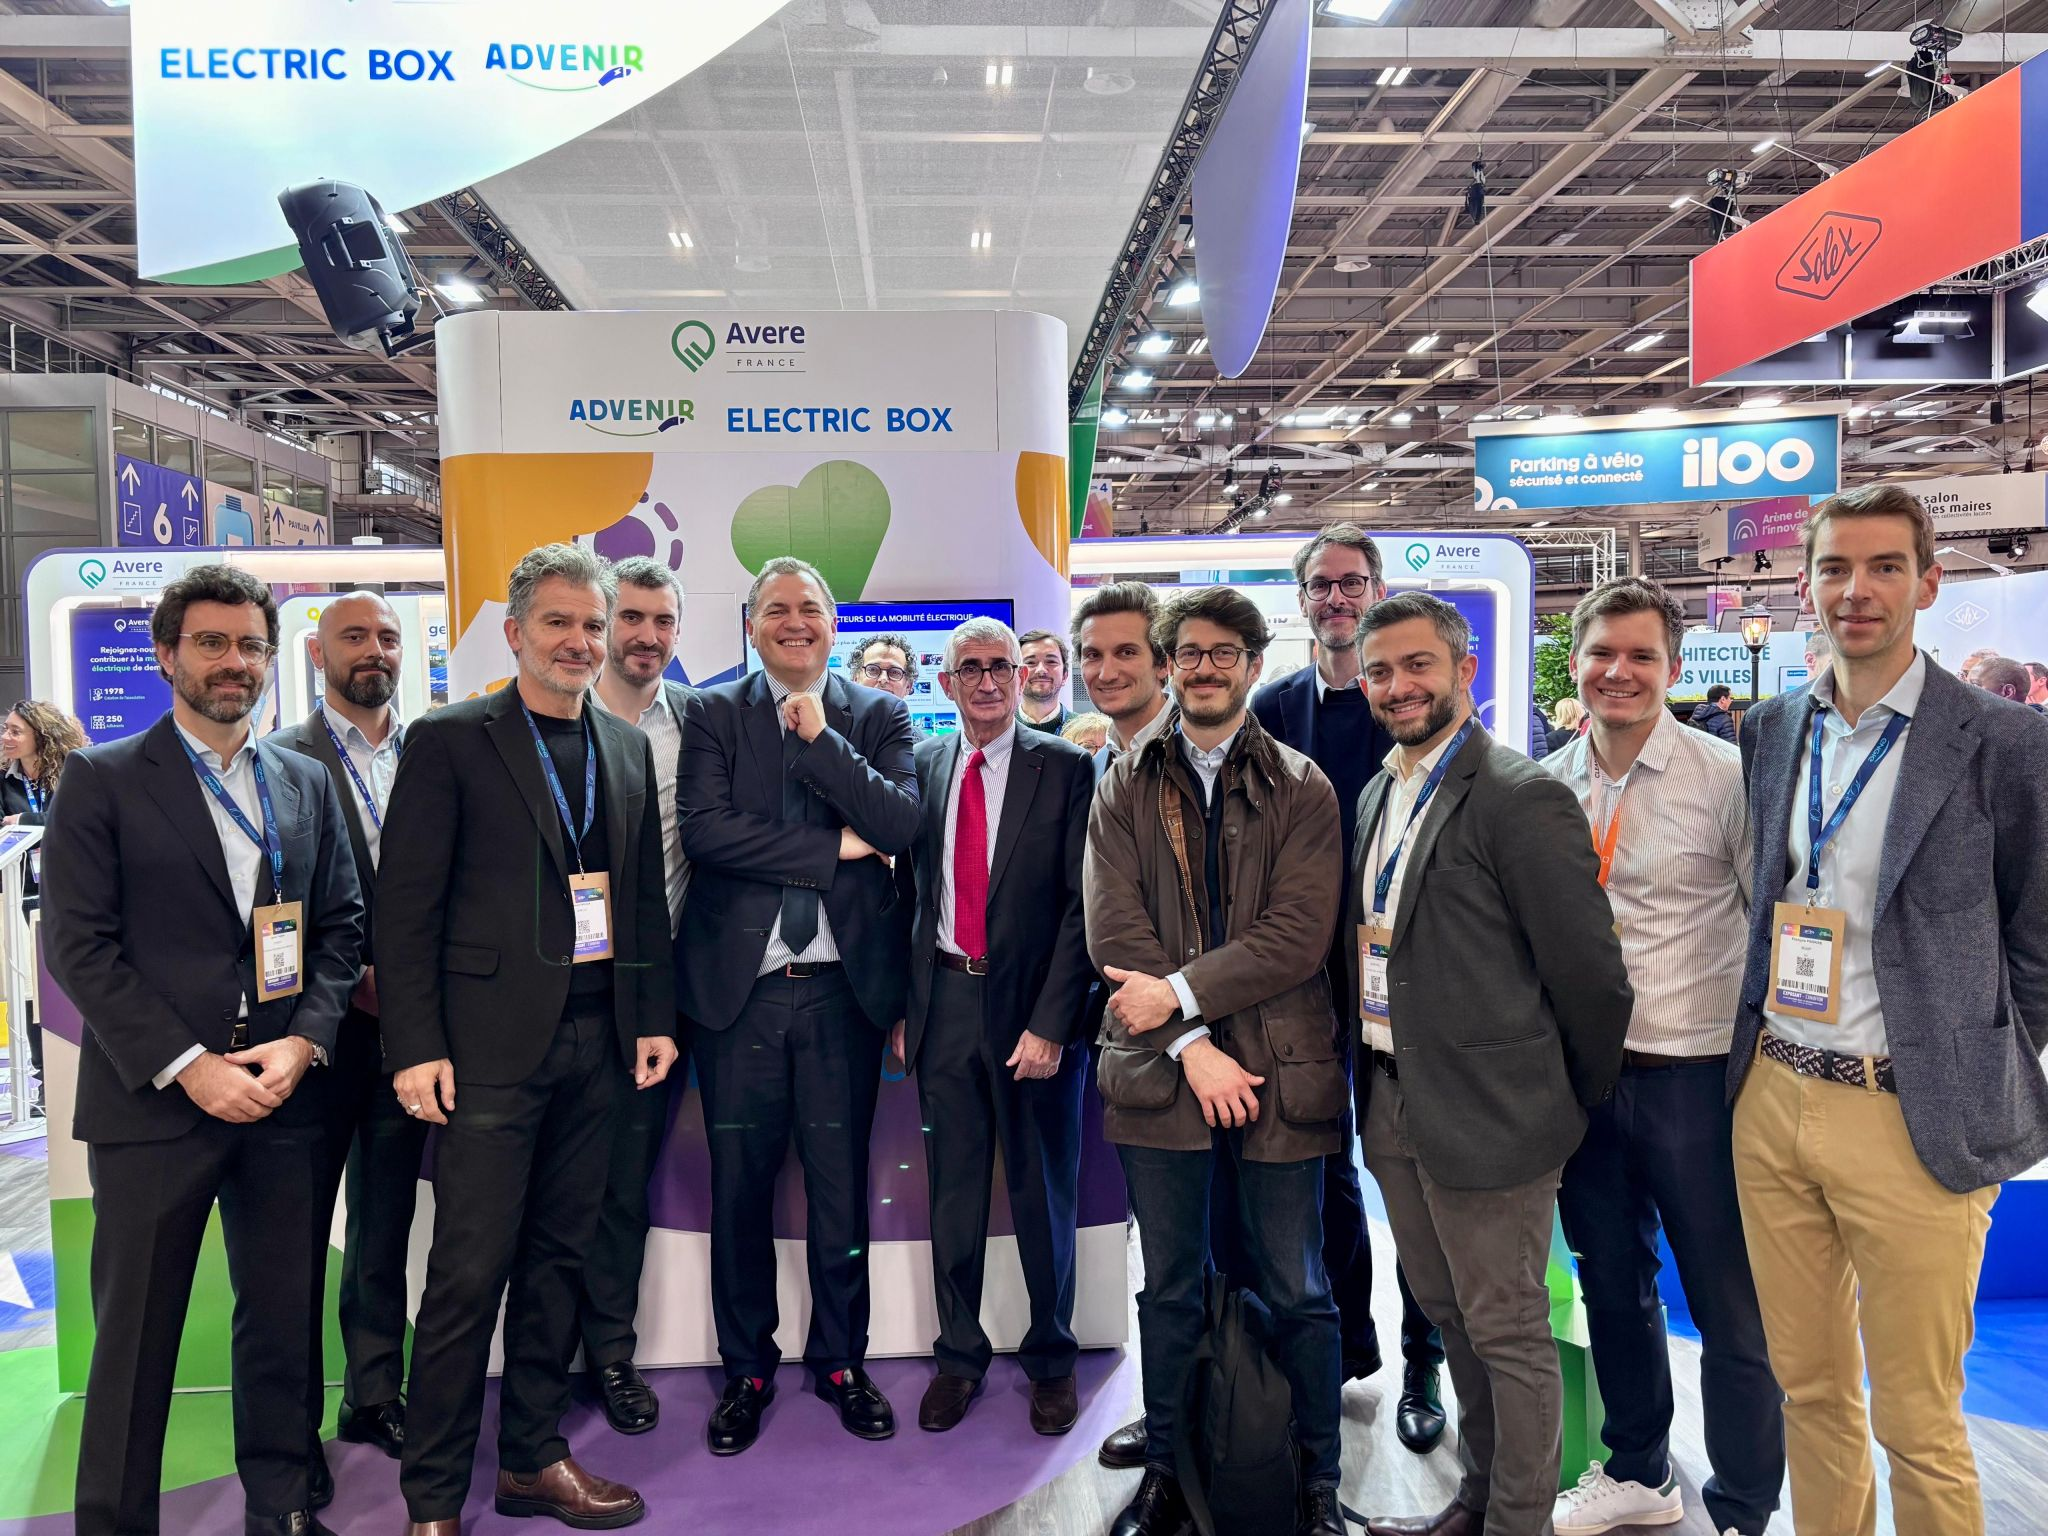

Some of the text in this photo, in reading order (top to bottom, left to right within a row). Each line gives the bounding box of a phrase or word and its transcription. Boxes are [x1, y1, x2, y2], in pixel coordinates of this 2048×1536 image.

[160, 48, 455, 81] ELECTRIC BOX
[485, 43, 644, 72] ADVENIR
[726, 322, 805, 344] Avere
[737, 359, 796, 367] FRANCE
[569, 399, 694, 421] ADVENIR
[727, 407, 953, 433] ELECTRIC BOX
[1510, 451, 1644, 474] Parking à vélo
[1682, 437, 1815, 487] iloo
[1510, 470, 1644, 487] sécurisé et connecté
[1924, 492, 1958, 504] salon
[1949, 501, 1991, 512] maires
[153, 503, 173, 545] 6
[1762, 509, 1808, 524] Arène de
[1436, 544, 1480, 557] Avere
[113, 560, 163, 573] Avere
[889, 613, 925, 622] MOBILITÉ
[90, 655, 128, 663] contribuer
[91, 665, 131, 673] électrique
[1698, 669, 1751, 684] VILLES
